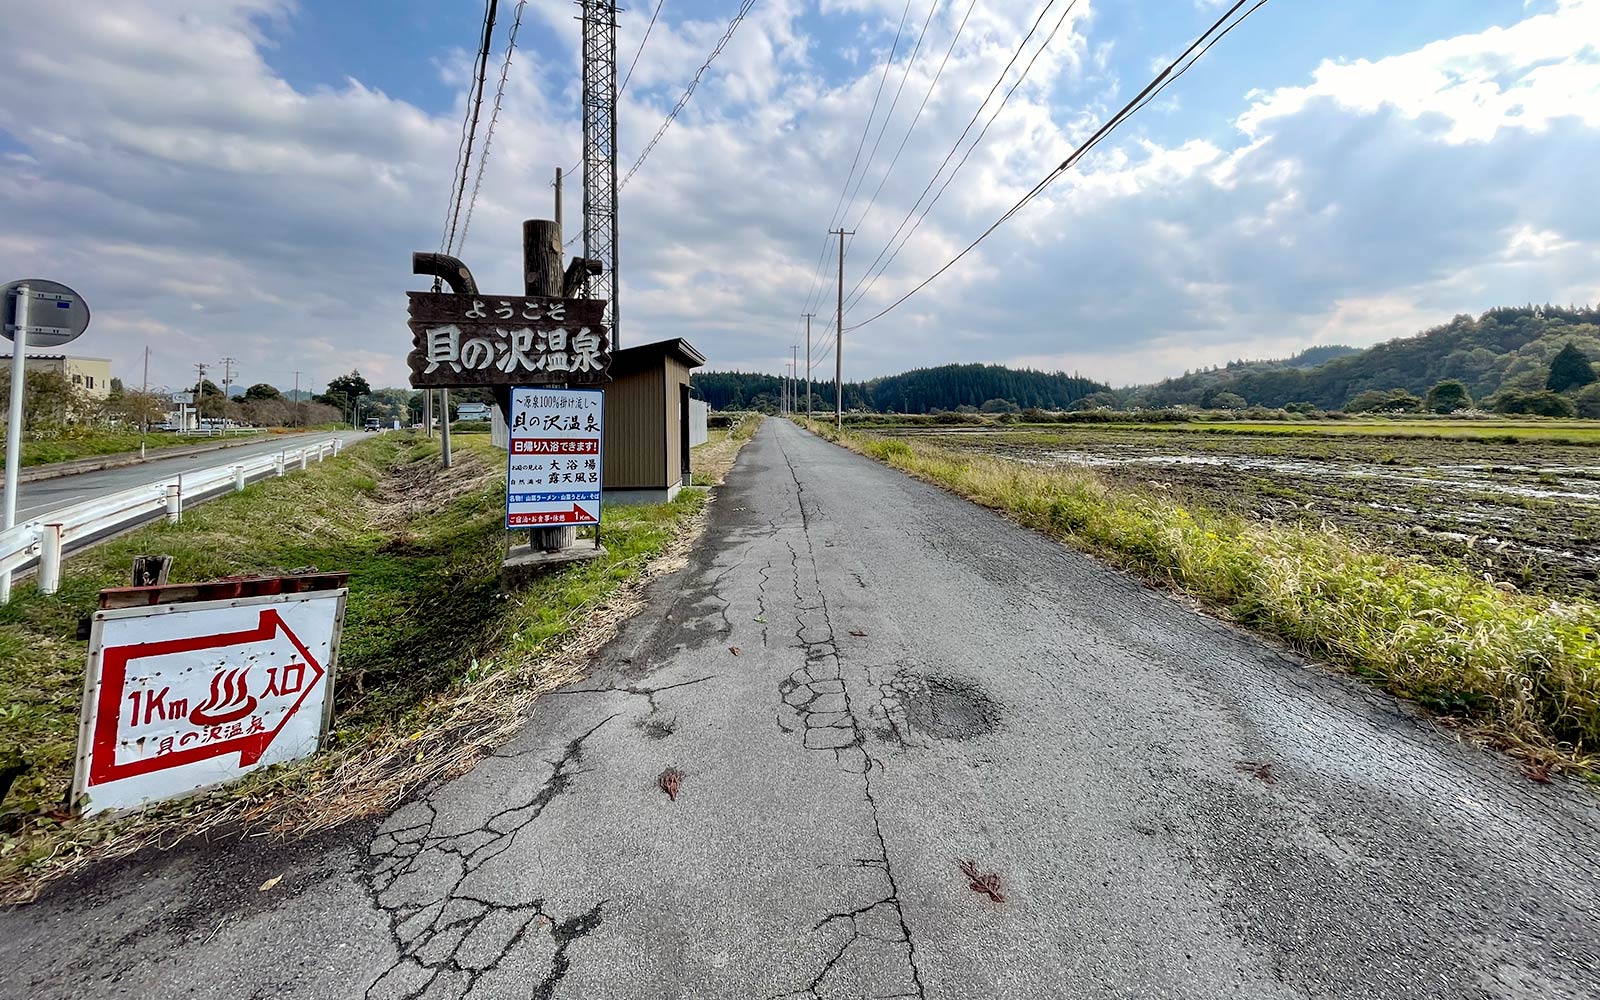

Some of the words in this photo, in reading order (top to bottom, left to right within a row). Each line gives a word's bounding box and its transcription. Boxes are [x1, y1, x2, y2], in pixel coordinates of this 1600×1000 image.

[465, 300, 567, 321] ようこそ
[424, 324, 604, 374] 貝の沢温泉
[513, 411, 600, 432] 貝の沢温泉
[548, 472, 598, 484] 露天風呂
[127, 686, 189, 727] 1Km
[260, 663, 306, 699] 入口
[157, 716, 266, 756] 貝の沢温泉
